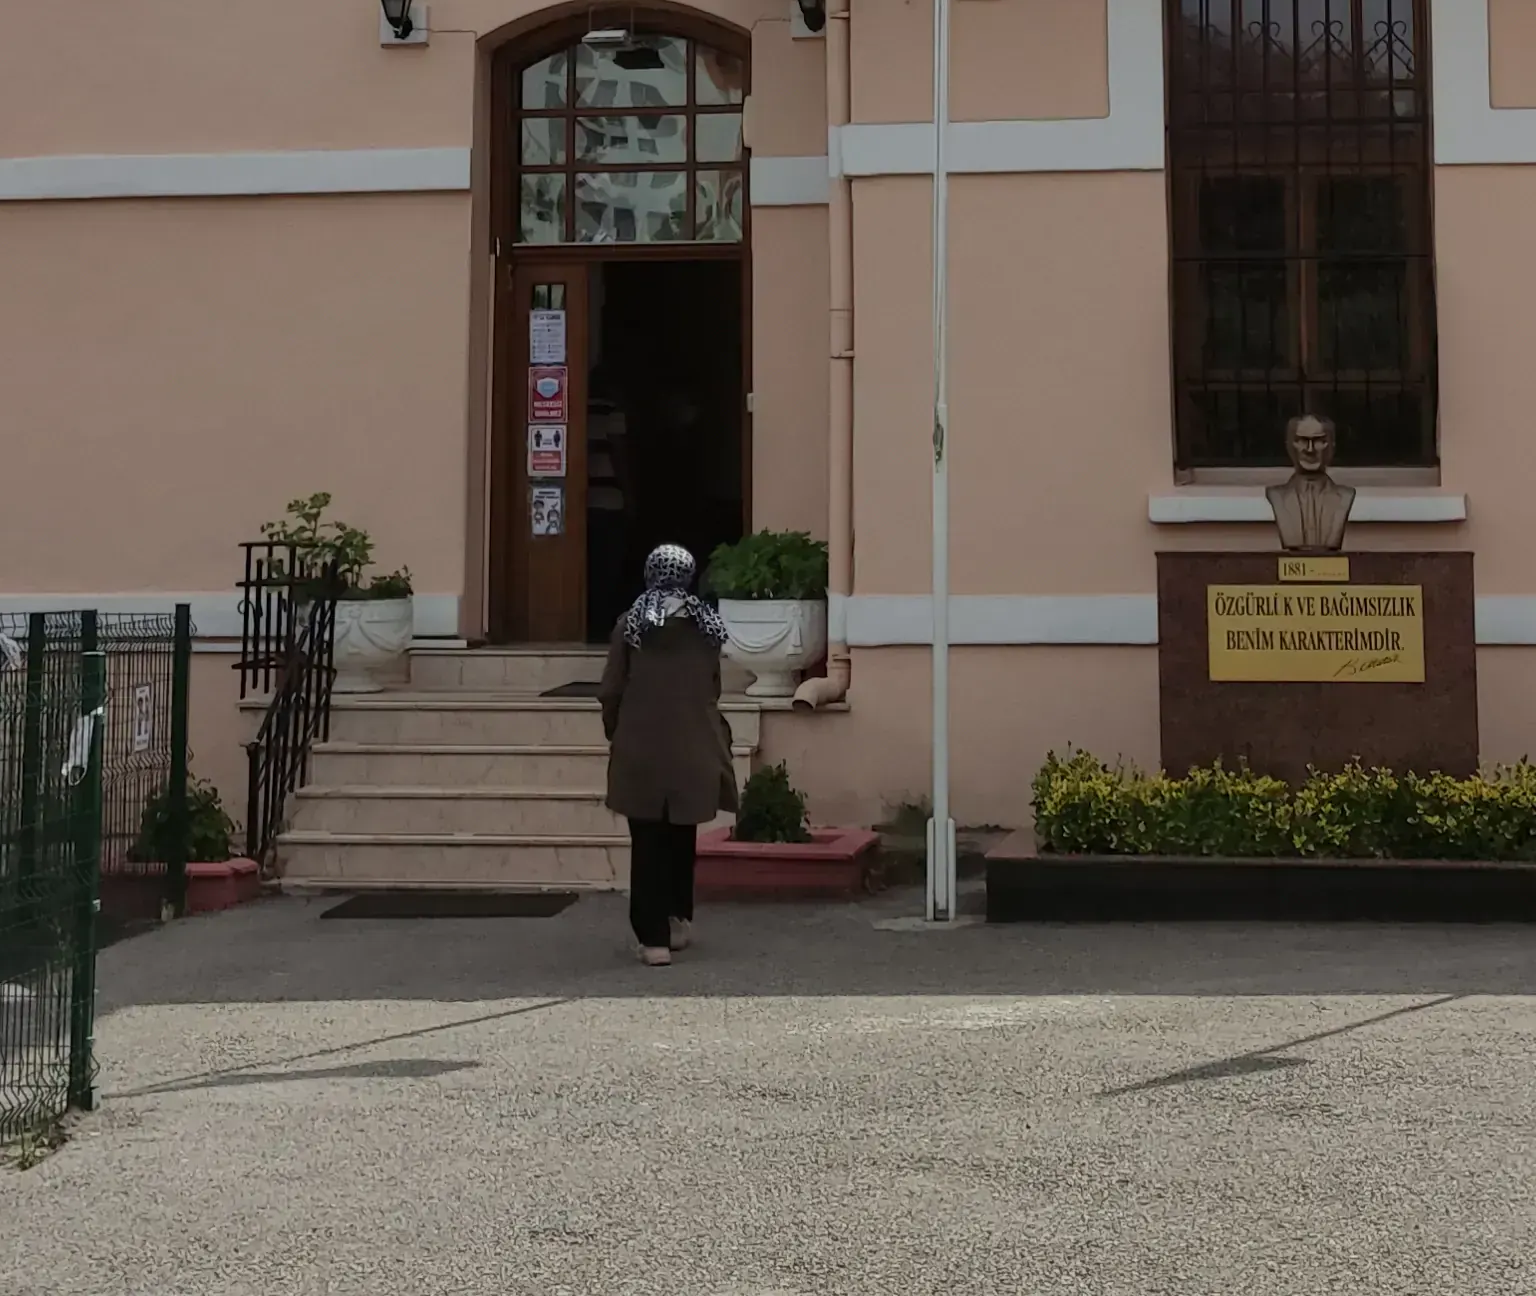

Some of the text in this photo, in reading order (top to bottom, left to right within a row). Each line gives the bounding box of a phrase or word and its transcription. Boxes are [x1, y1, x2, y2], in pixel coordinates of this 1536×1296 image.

[1284, 563, 1305, 577] 1881
[1297, 596, 1315, 616] VE
[1320, 592, 1416, 617] BAĞIMSIZLIK
[1226, 628, 1405, 651] BENİM KARAKTERİMDİR.
